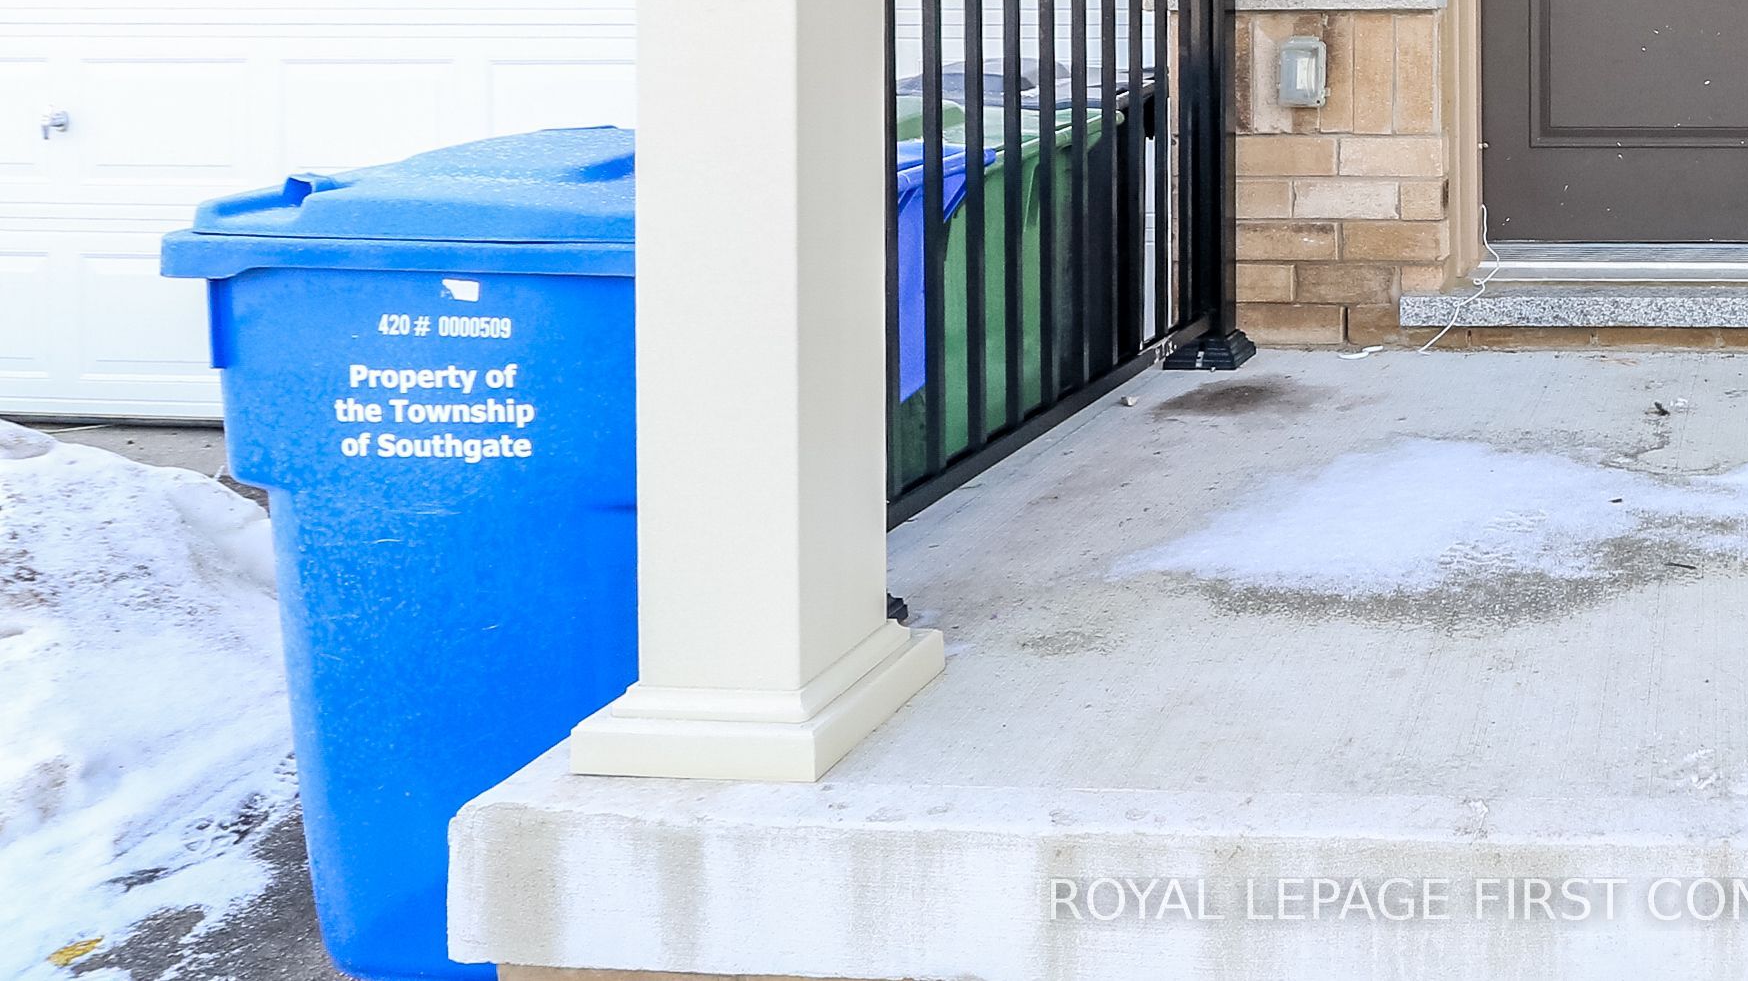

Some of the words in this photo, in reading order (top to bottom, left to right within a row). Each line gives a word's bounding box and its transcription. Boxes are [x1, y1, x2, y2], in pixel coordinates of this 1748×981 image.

[378, 314, 410, 336] 420
[413, 316, 431, 337] #
[438, 316, 512, 339] 0000509
[349, 364, 477, 394] Property
[485, 364, 518, 389] of
[334, 398, 383, 423] the
[388, 398, 535, 428] Township
[341, 432, 371, 457] of
[377, 433, 532, 464] Southgate
